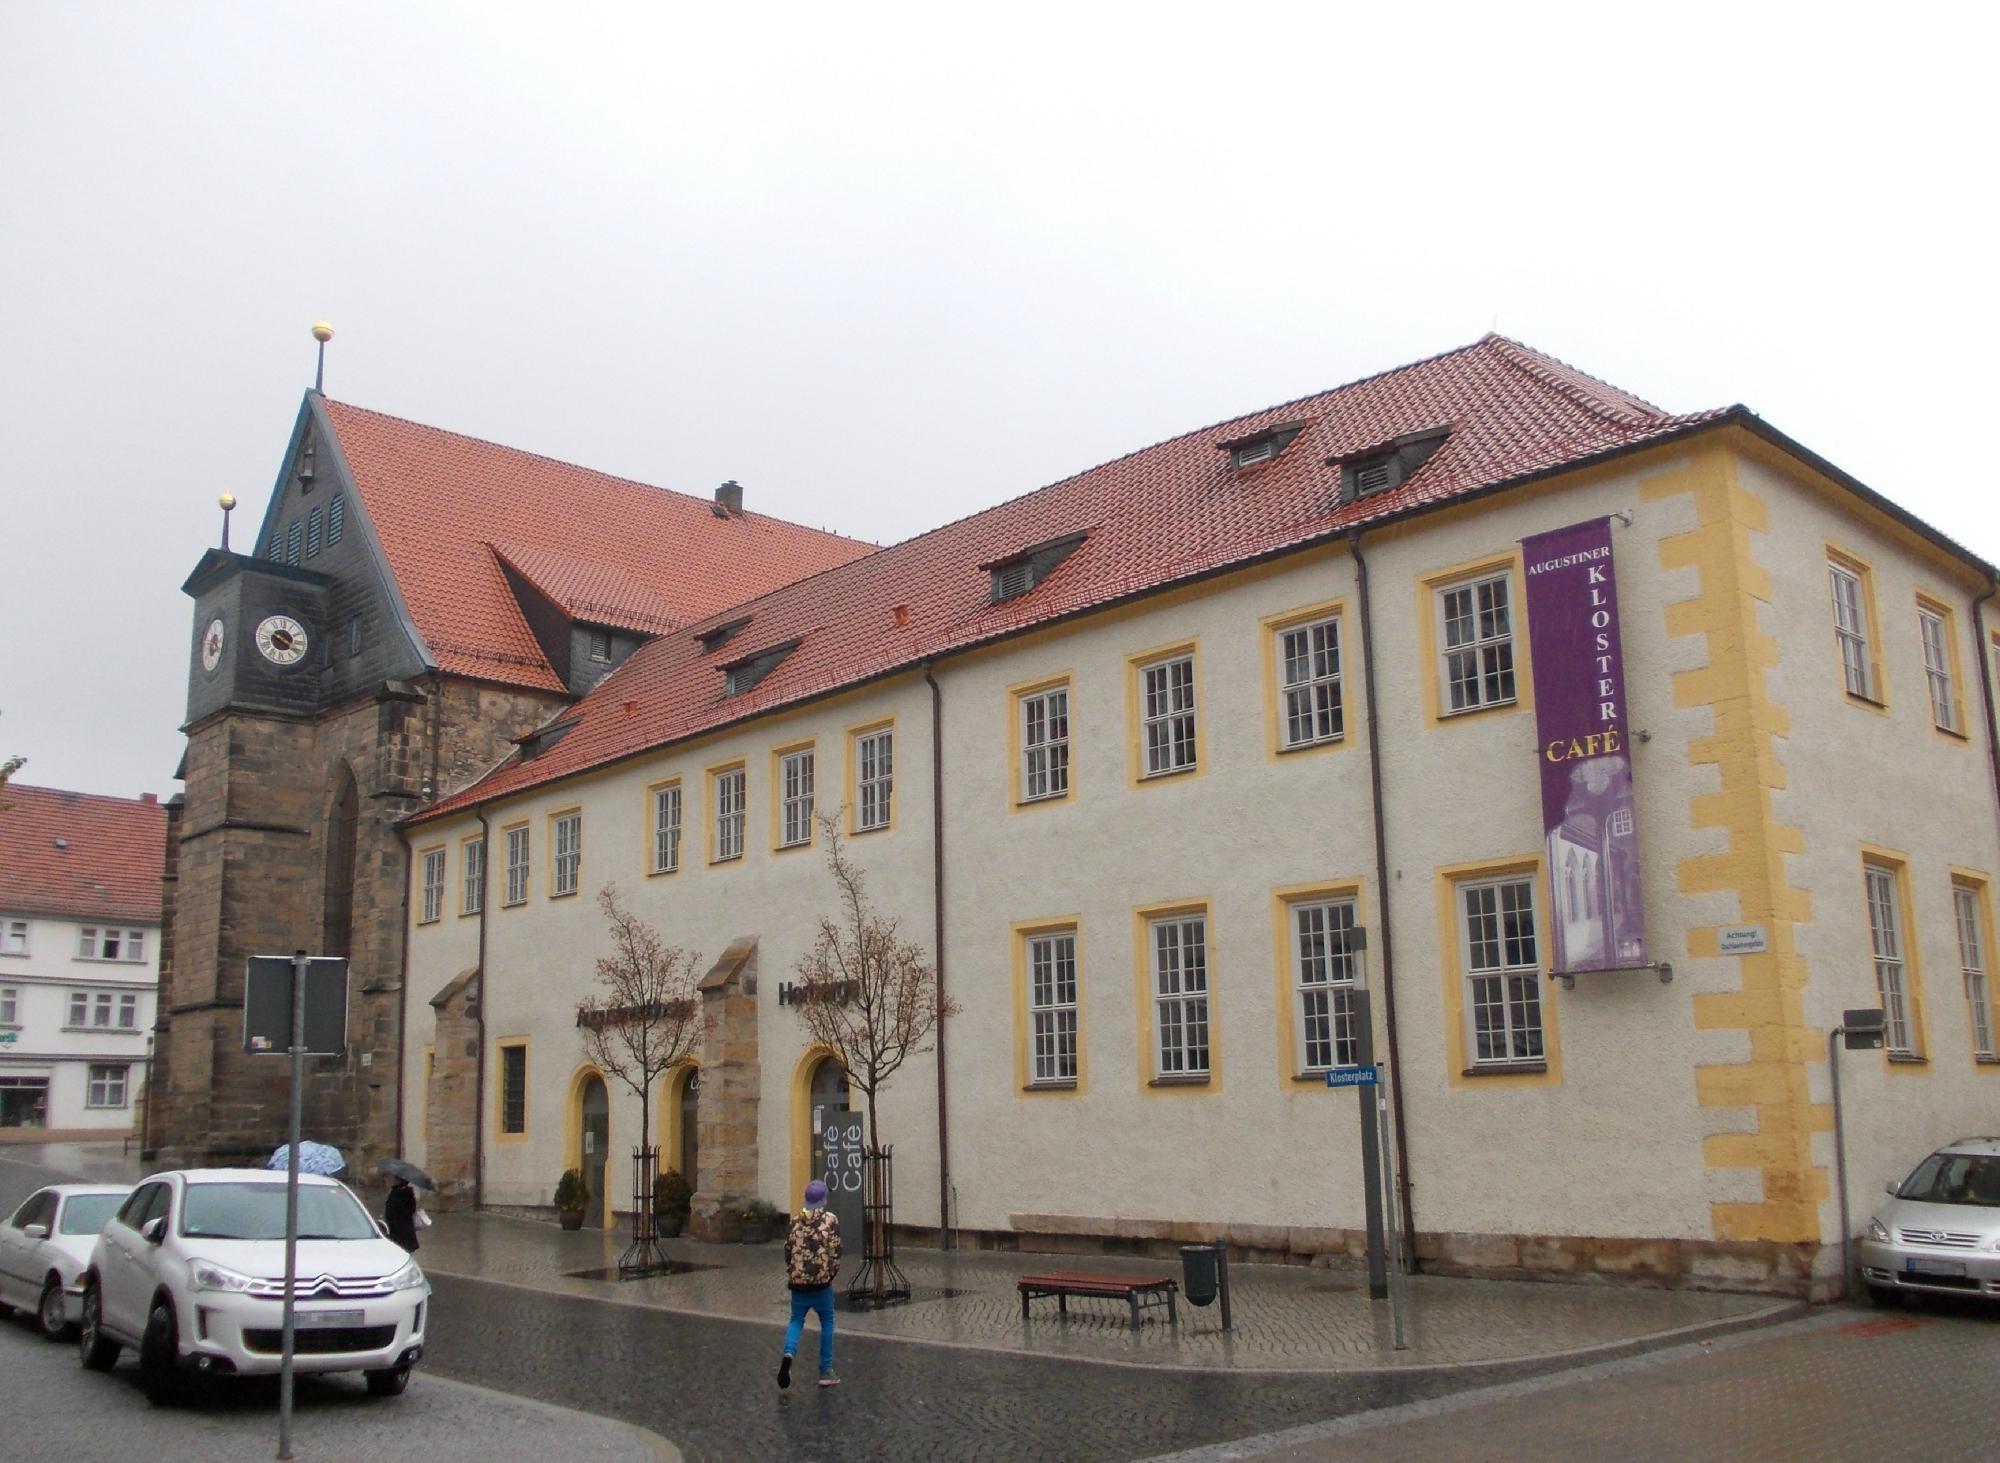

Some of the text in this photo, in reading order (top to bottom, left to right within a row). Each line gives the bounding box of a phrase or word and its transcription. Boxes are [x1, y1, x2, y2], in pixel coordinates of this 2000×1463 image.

[1527, 546, 1611, 576] AUGUSTINER
[1588, 564, 1617, 722] KLOSTER
[1546, 724, 1621, 763] CAFÉ
[1329, 1070, 1374, 1084] Klosterplatz
